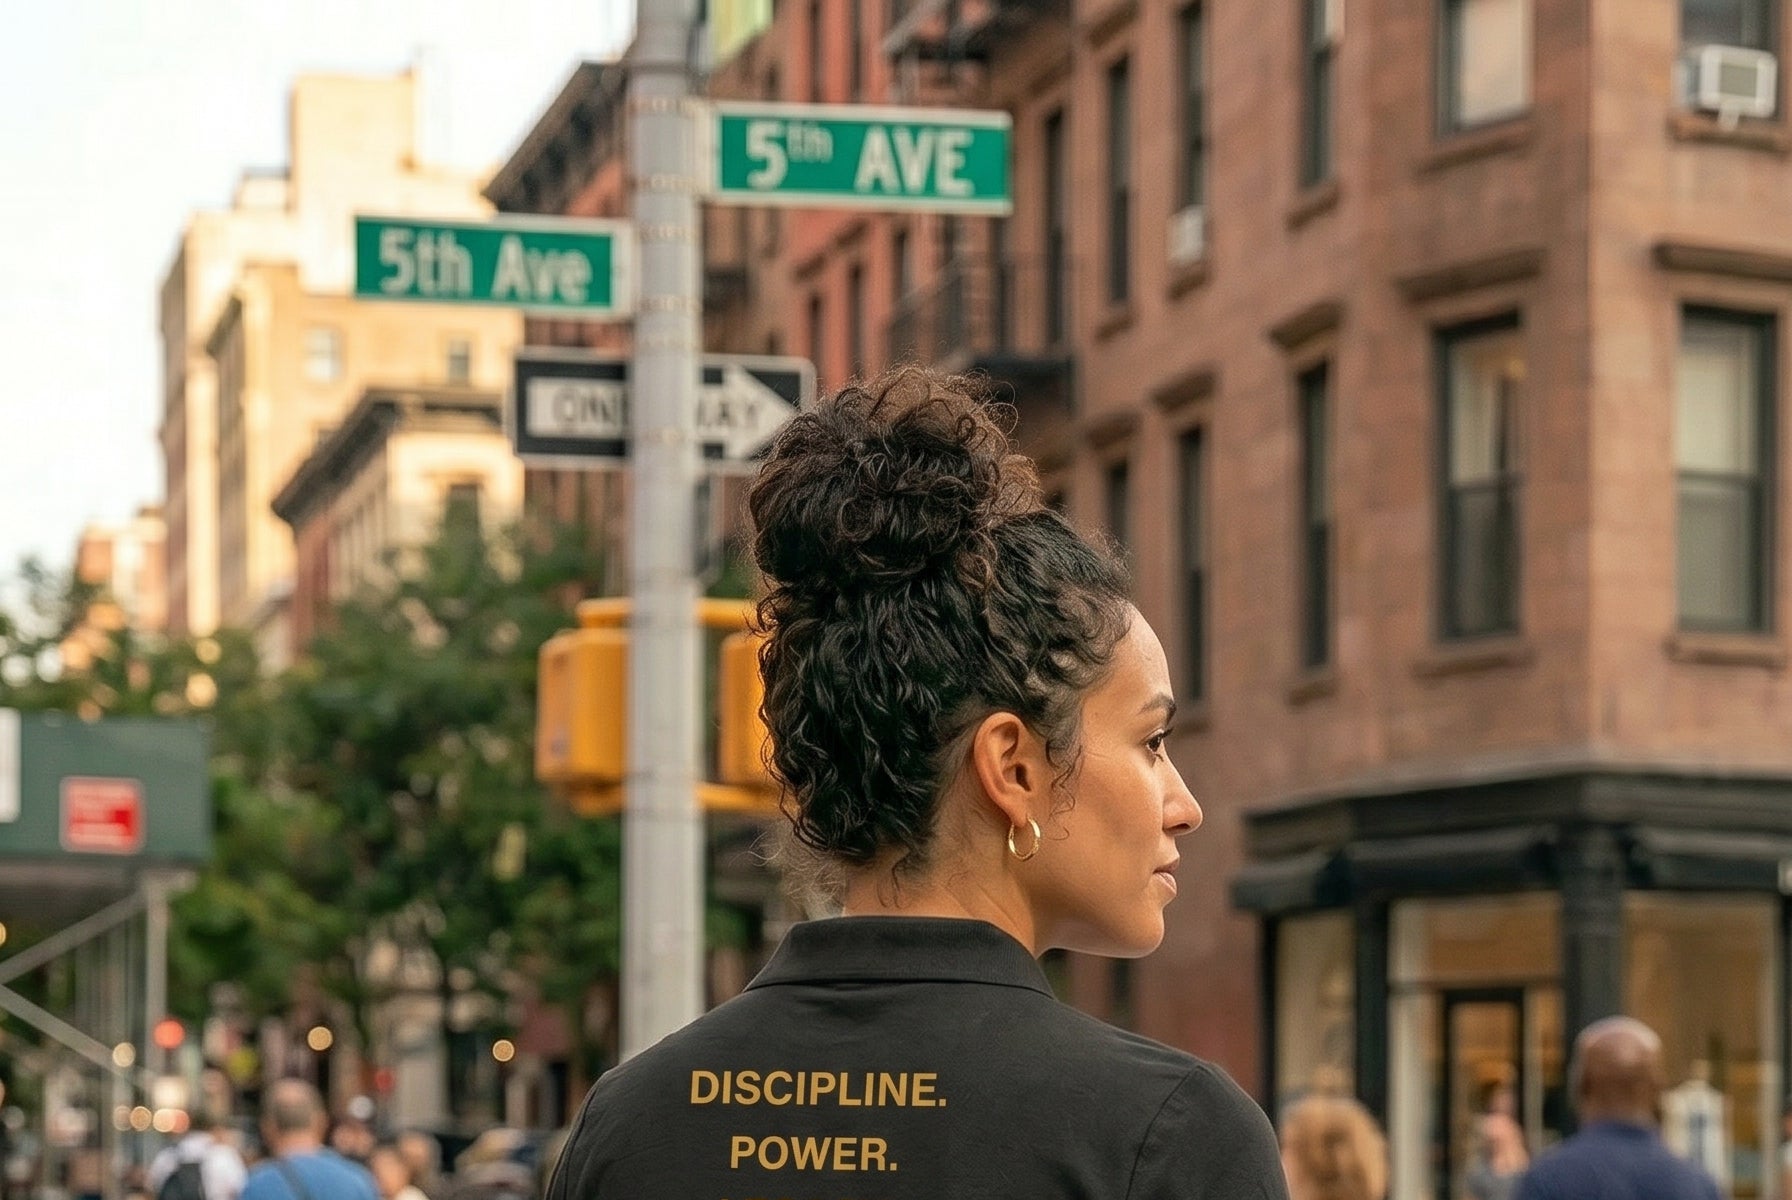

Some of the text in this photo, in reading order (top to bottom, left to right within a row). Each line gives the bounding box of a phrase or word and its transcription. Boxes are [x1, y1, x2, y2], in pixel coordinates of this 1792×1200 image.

[746, 120, 974, 196] 5th AVE
[379, 227, 593, 304] 5th Ave
[690, 1070, 947, 1107] DISCIPLINE.
[730, 1135, 898, 1171] POWER.
